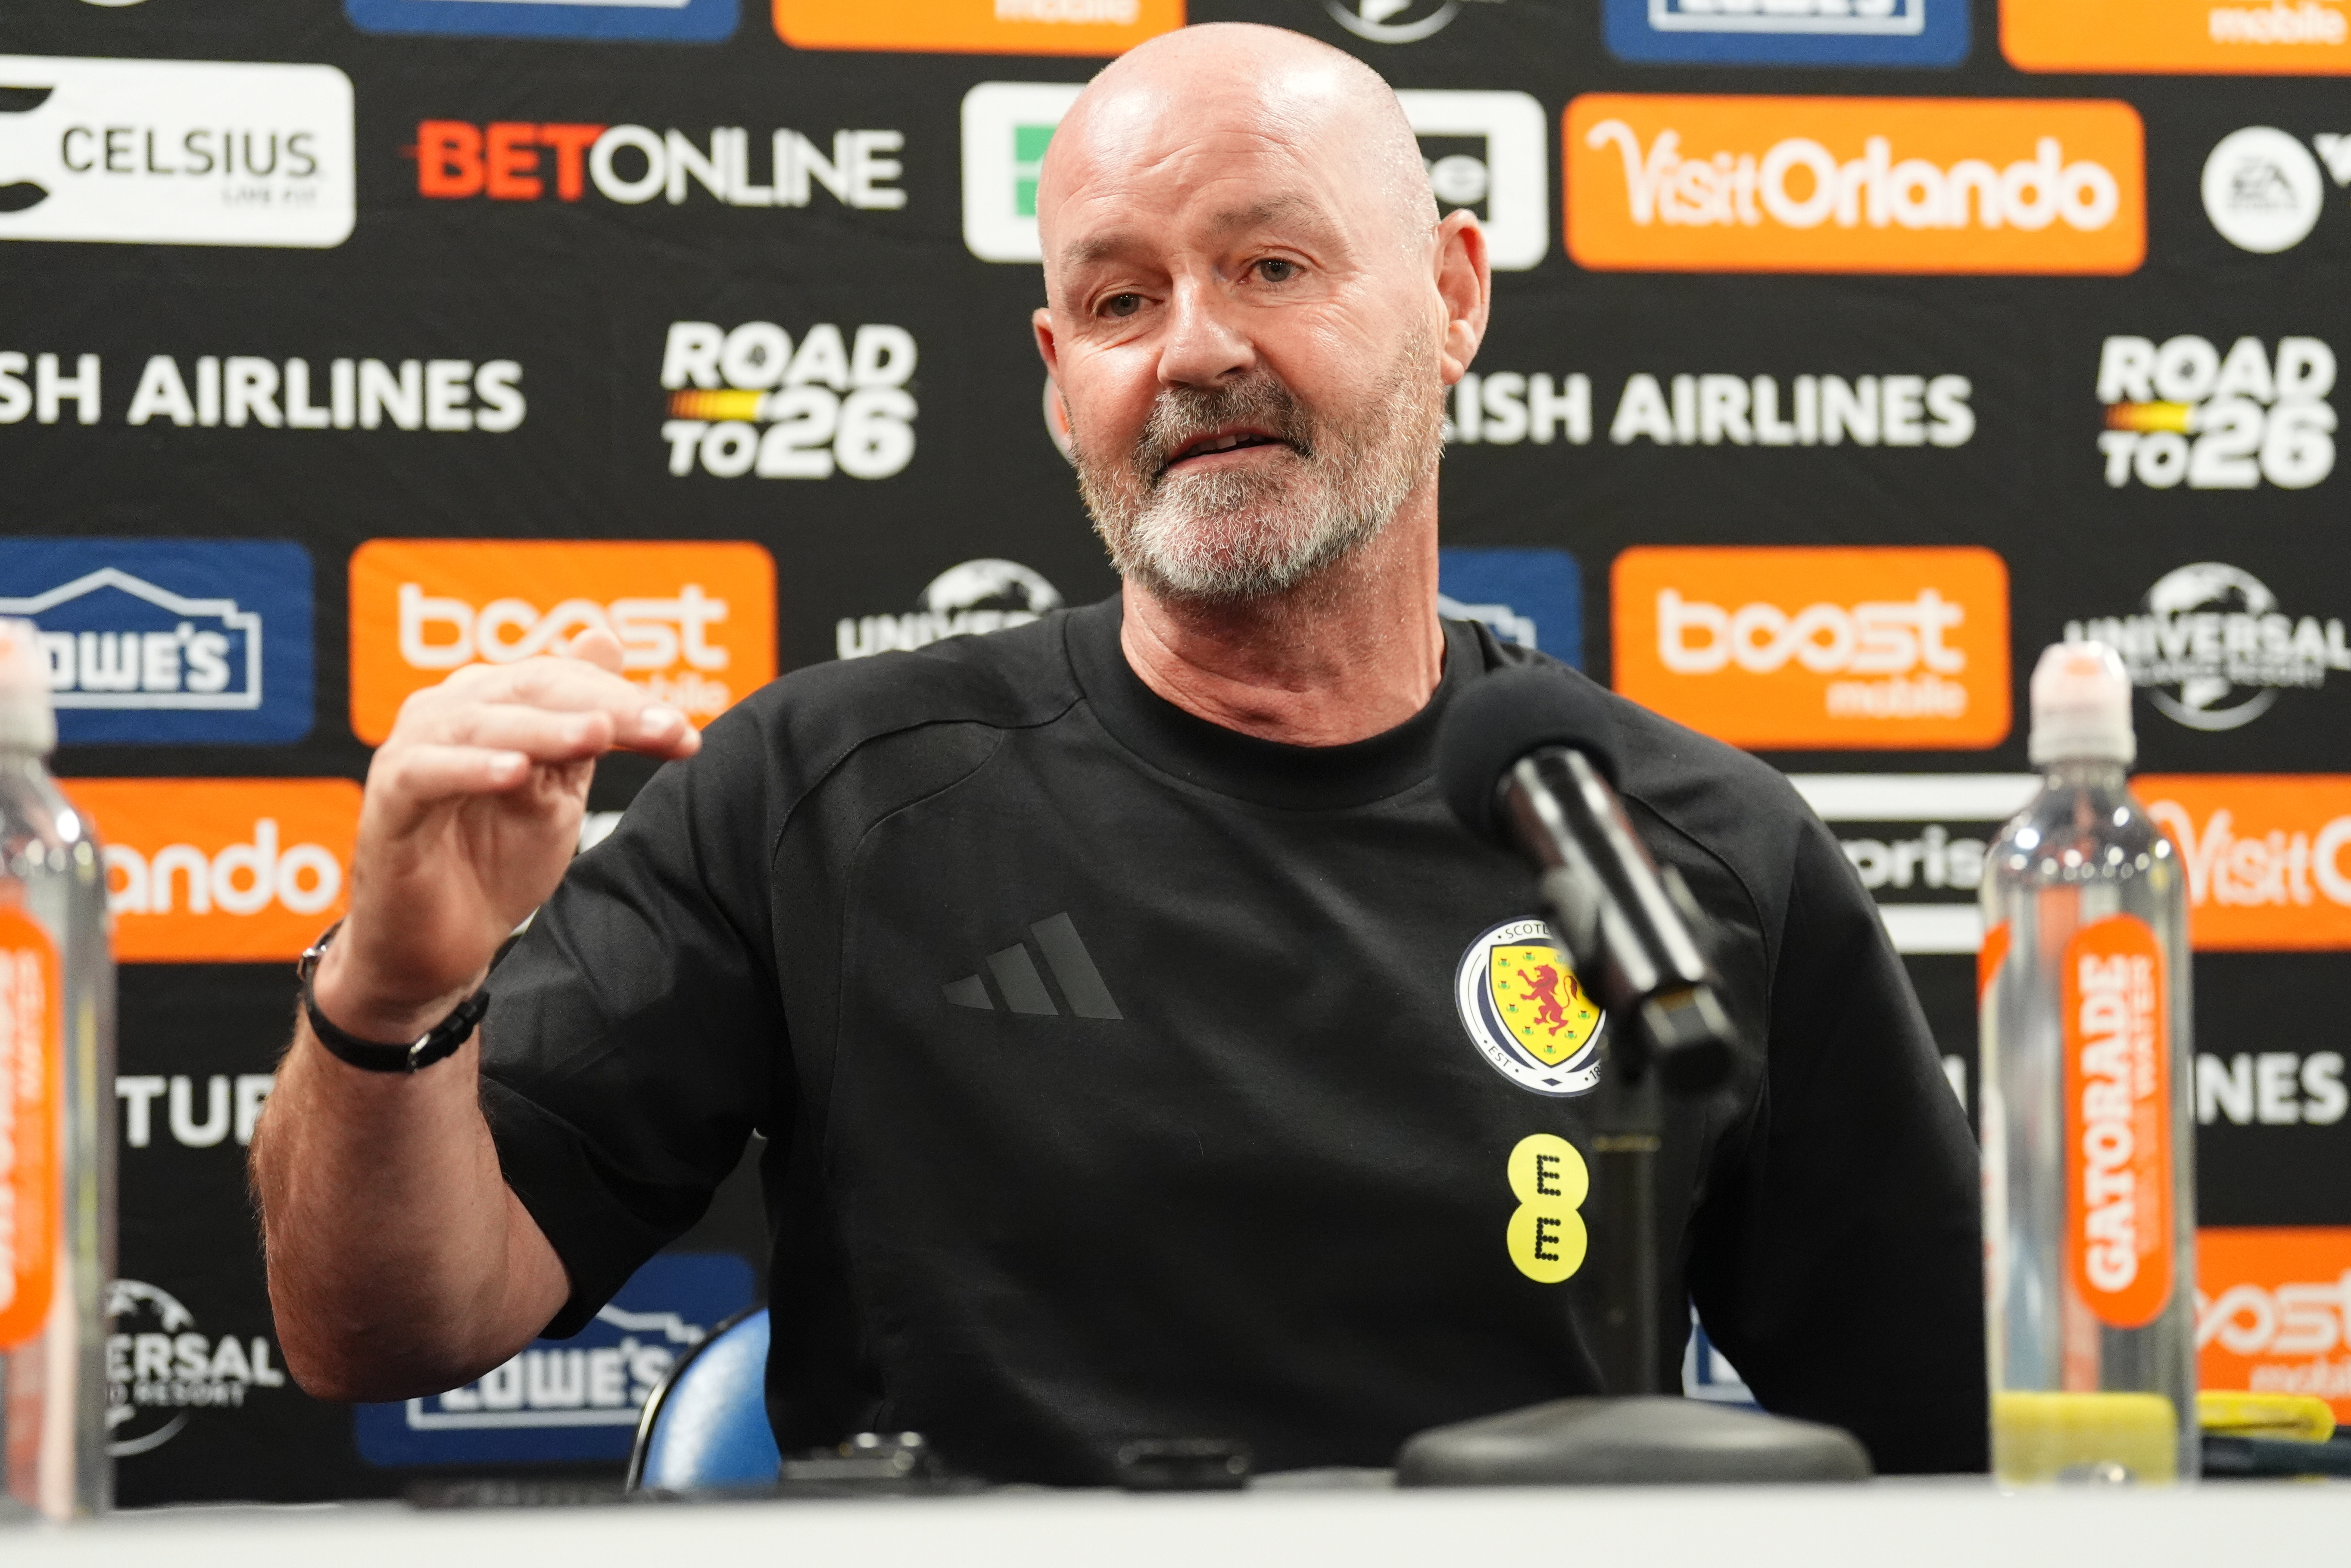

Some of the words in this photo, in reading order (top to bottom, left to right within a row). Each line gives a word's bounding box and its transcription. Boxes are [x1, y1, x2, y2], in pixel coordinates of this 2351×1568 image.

[2208, 0, 2348, 45] mobile
[61, 126, 319, 178] CELSIUS
[1585, 119, 2119, 233] VisitOrlando
[660, 320, 918, 390] ROAD
[2095, 334, 2338, 404] ROAD
[125, 353, 527, 432] AIRLINES
[1444, 370, 1593, 445] ISH
[1609, 372, 1977, 448] AIRLINES
[660, 420, 760, 478] TO
[754, 384, 918, 480] 26
[2096, 430, 2190, 489] TO
[2185, 397, 2339, 490] 26
[45, 622, 232, 692] OWE'S
[398, 582, 730, 670] boost
[1656, 587, 1966, 675] boost
[1825, 672, 1968, 720] mobile
[103, 817, 343, 916] ando
[1505, 923, 1550, 939] SCOTL
[1488, 1045, 1512, 1068] EST
[1589, 1066, 1602, 1080] 18
[2079, 953, 2138, 1292] GATORADE
[105, 1333, 285, 1388] ERSAL
